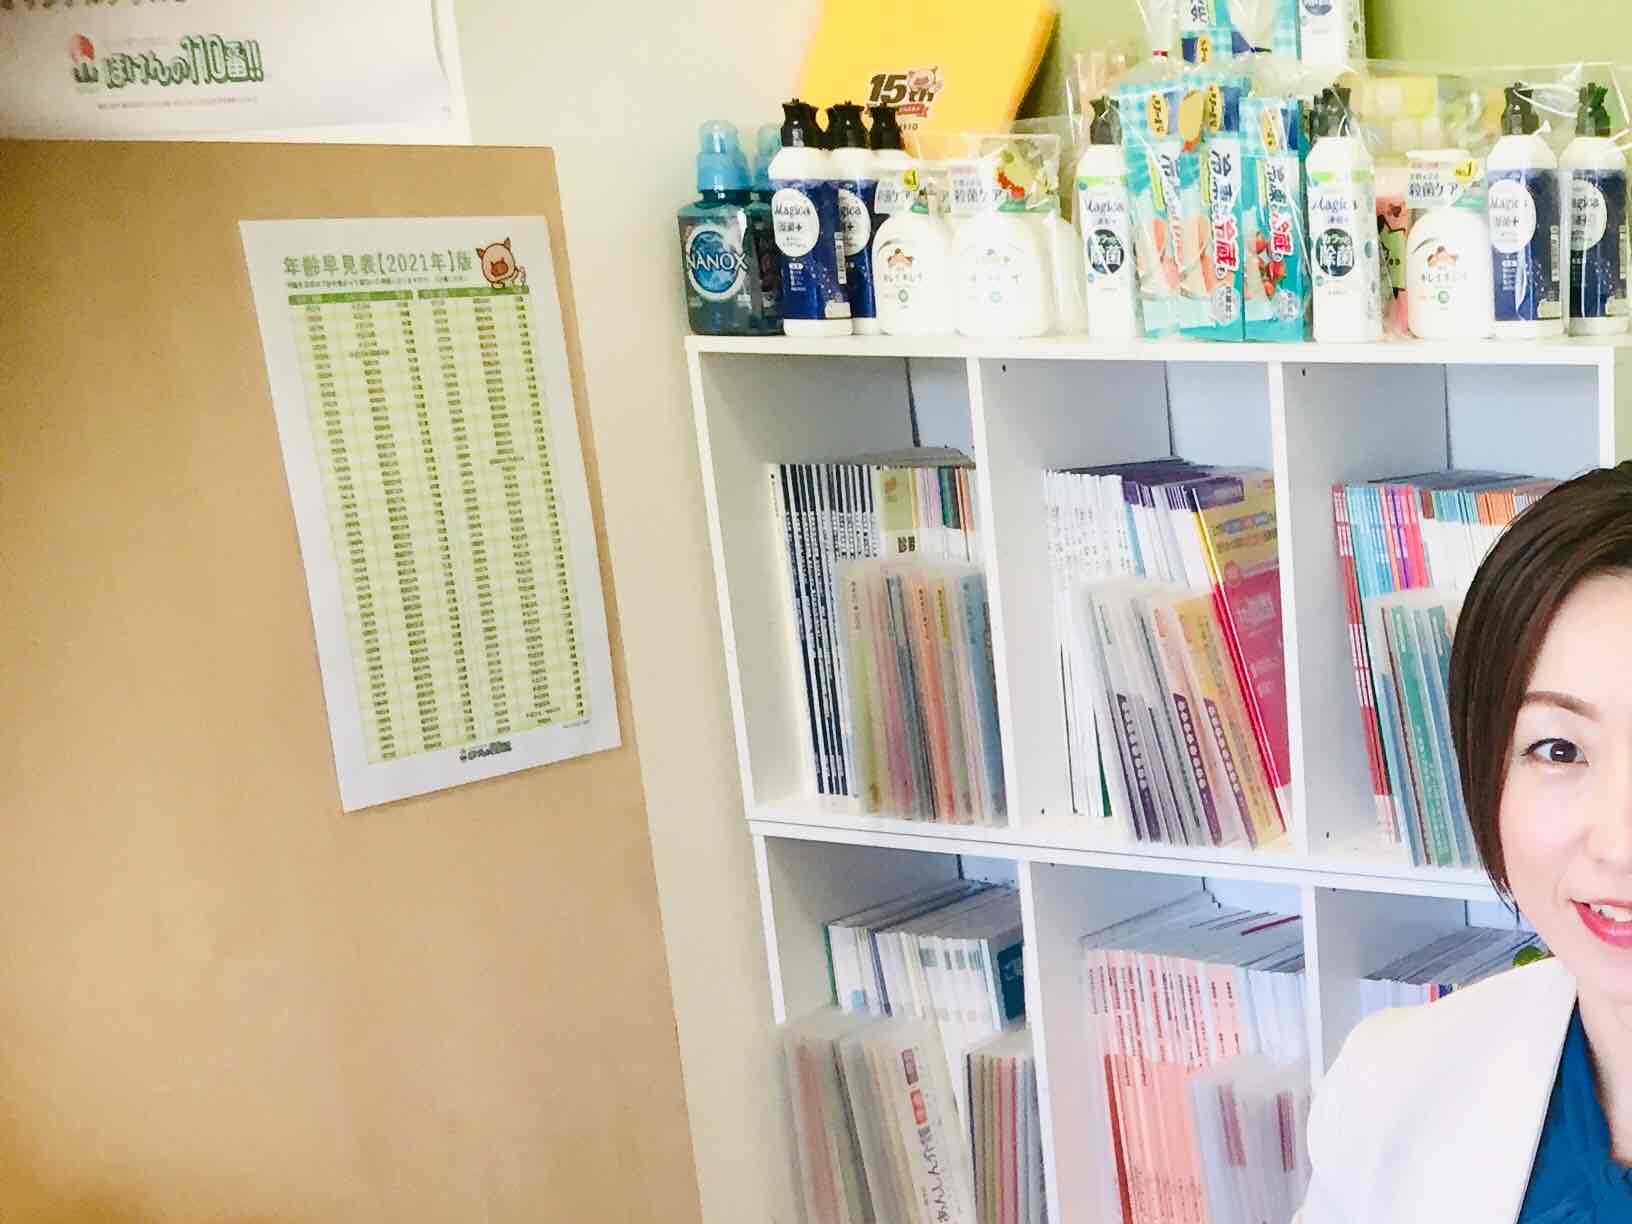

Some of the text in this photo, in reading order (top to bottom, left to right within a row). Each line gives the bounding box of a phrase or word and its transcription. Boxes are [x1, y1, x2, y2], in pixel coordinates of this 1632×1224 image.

[774, 204, 812, 216] Magica
[283, 248, 473, 278] 年齢早見表【2021年】版
[686, 252, 748, 271] NANOX
